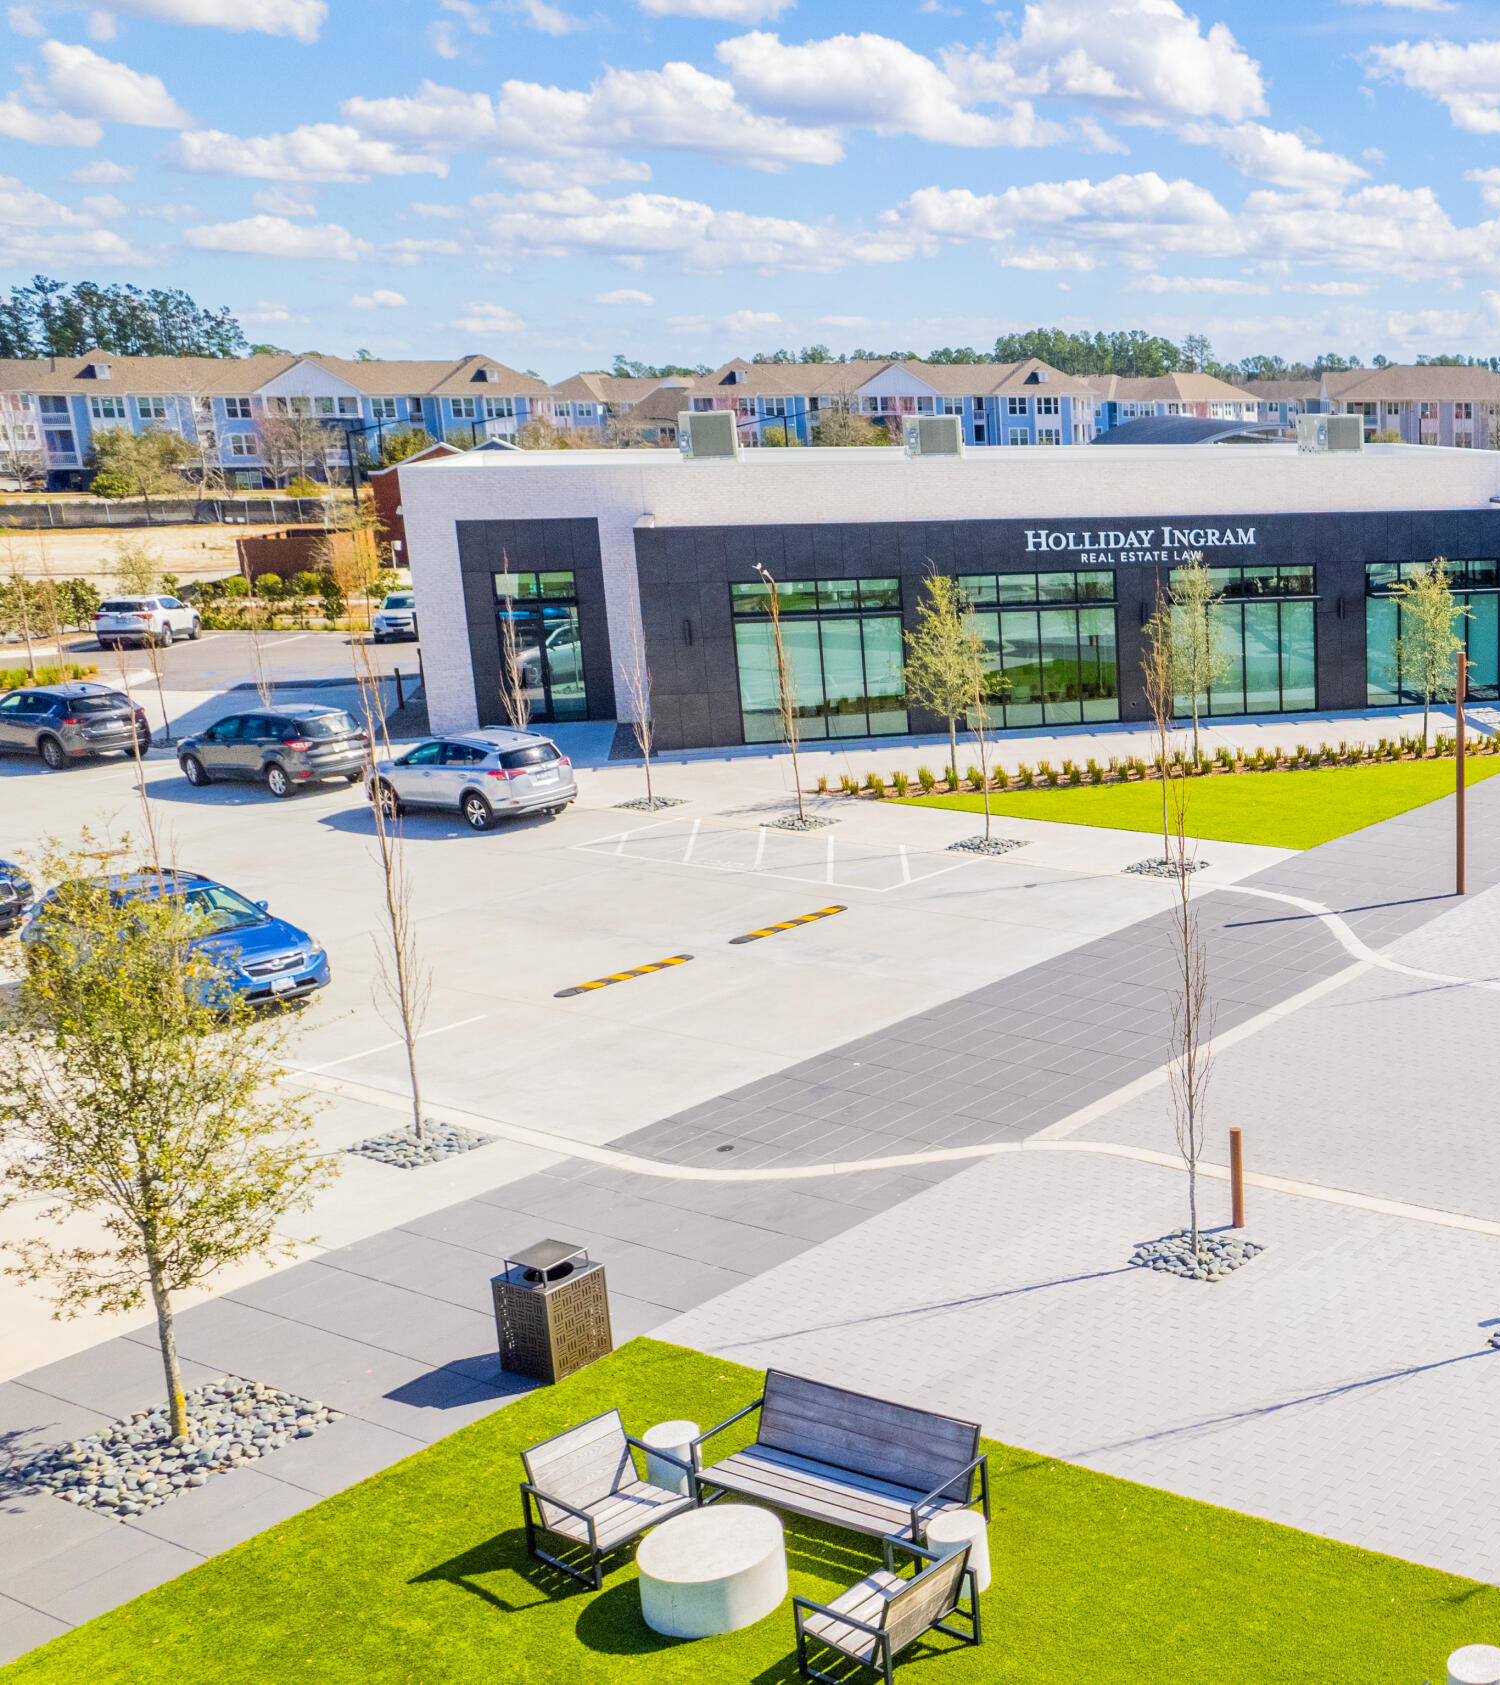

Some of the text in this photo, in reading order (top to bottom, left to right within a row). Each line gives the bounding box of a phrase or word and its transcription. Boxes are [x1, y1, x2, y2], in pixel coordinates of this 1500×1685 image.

[1024, 526, 1256, 552] HOLLIDAY INGRAM
[1080, 550, 1203, 564] REAL ESTATE LAW
